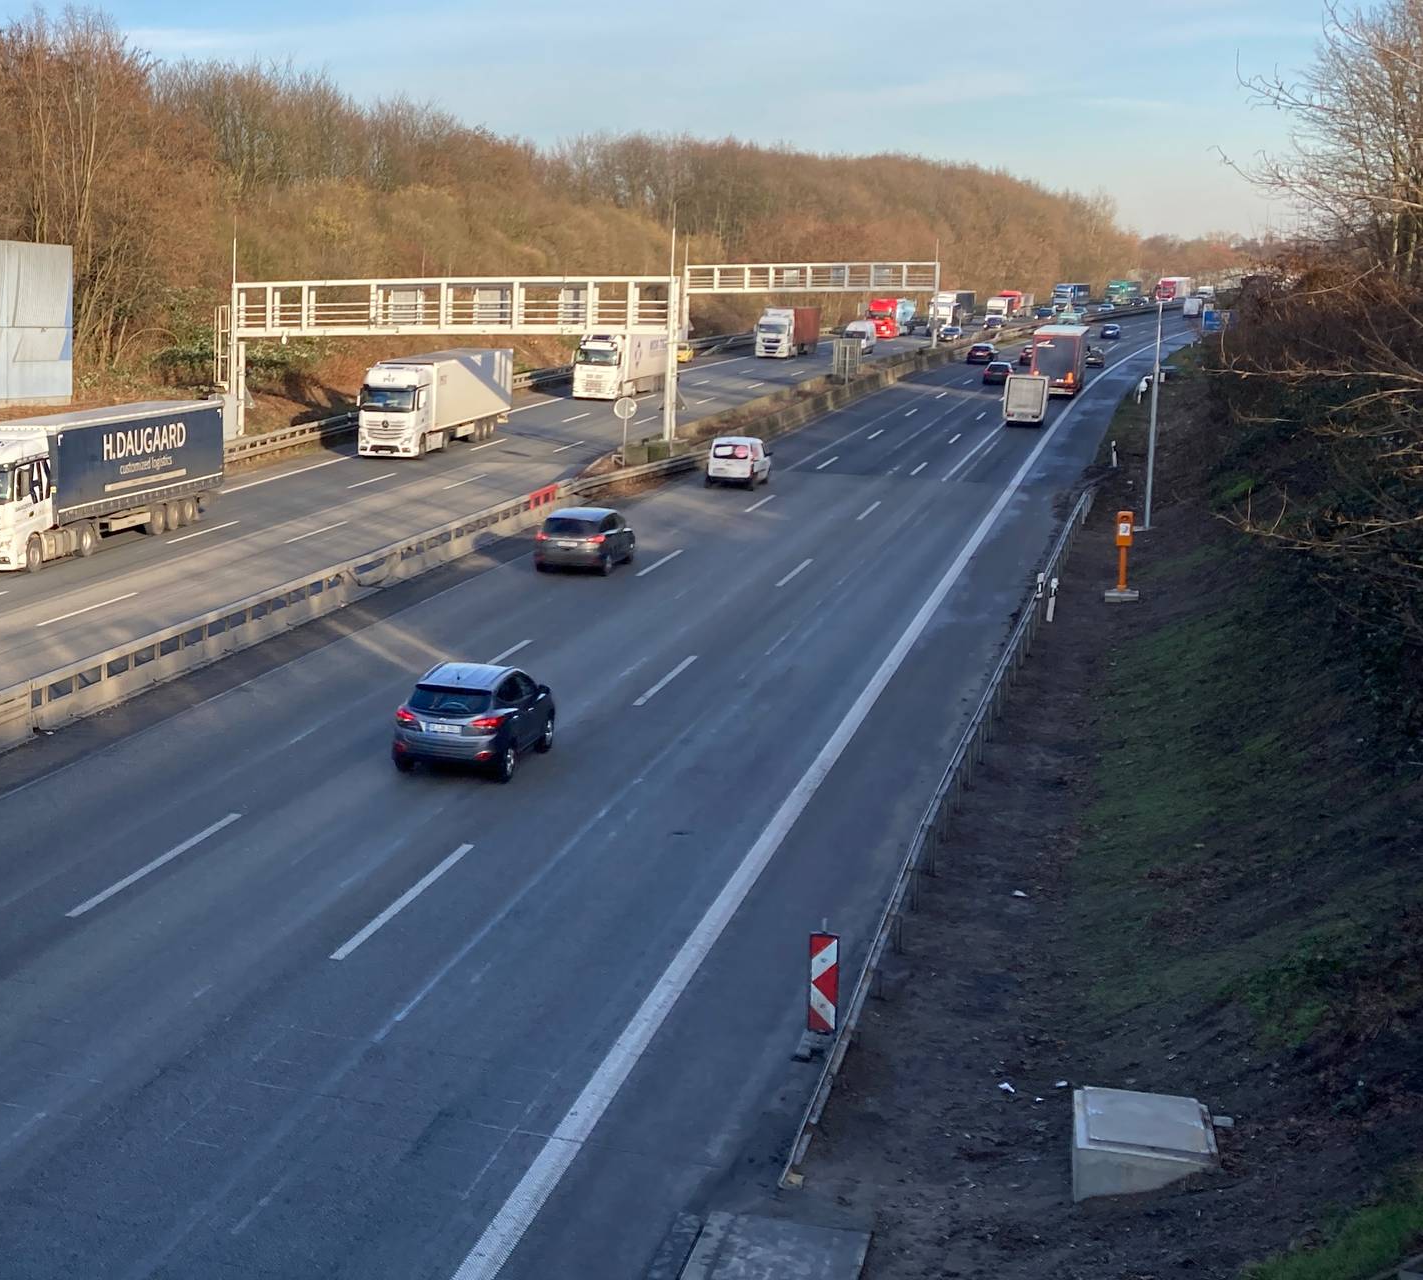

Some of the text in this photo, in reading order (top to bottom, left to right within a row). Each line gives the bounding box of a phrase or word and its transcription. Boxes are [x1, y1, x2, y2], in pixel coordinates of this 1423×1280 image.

[103, 422, 186, 461] H.DAUGAARD
[120, 455, 173, 475] customized logistics
